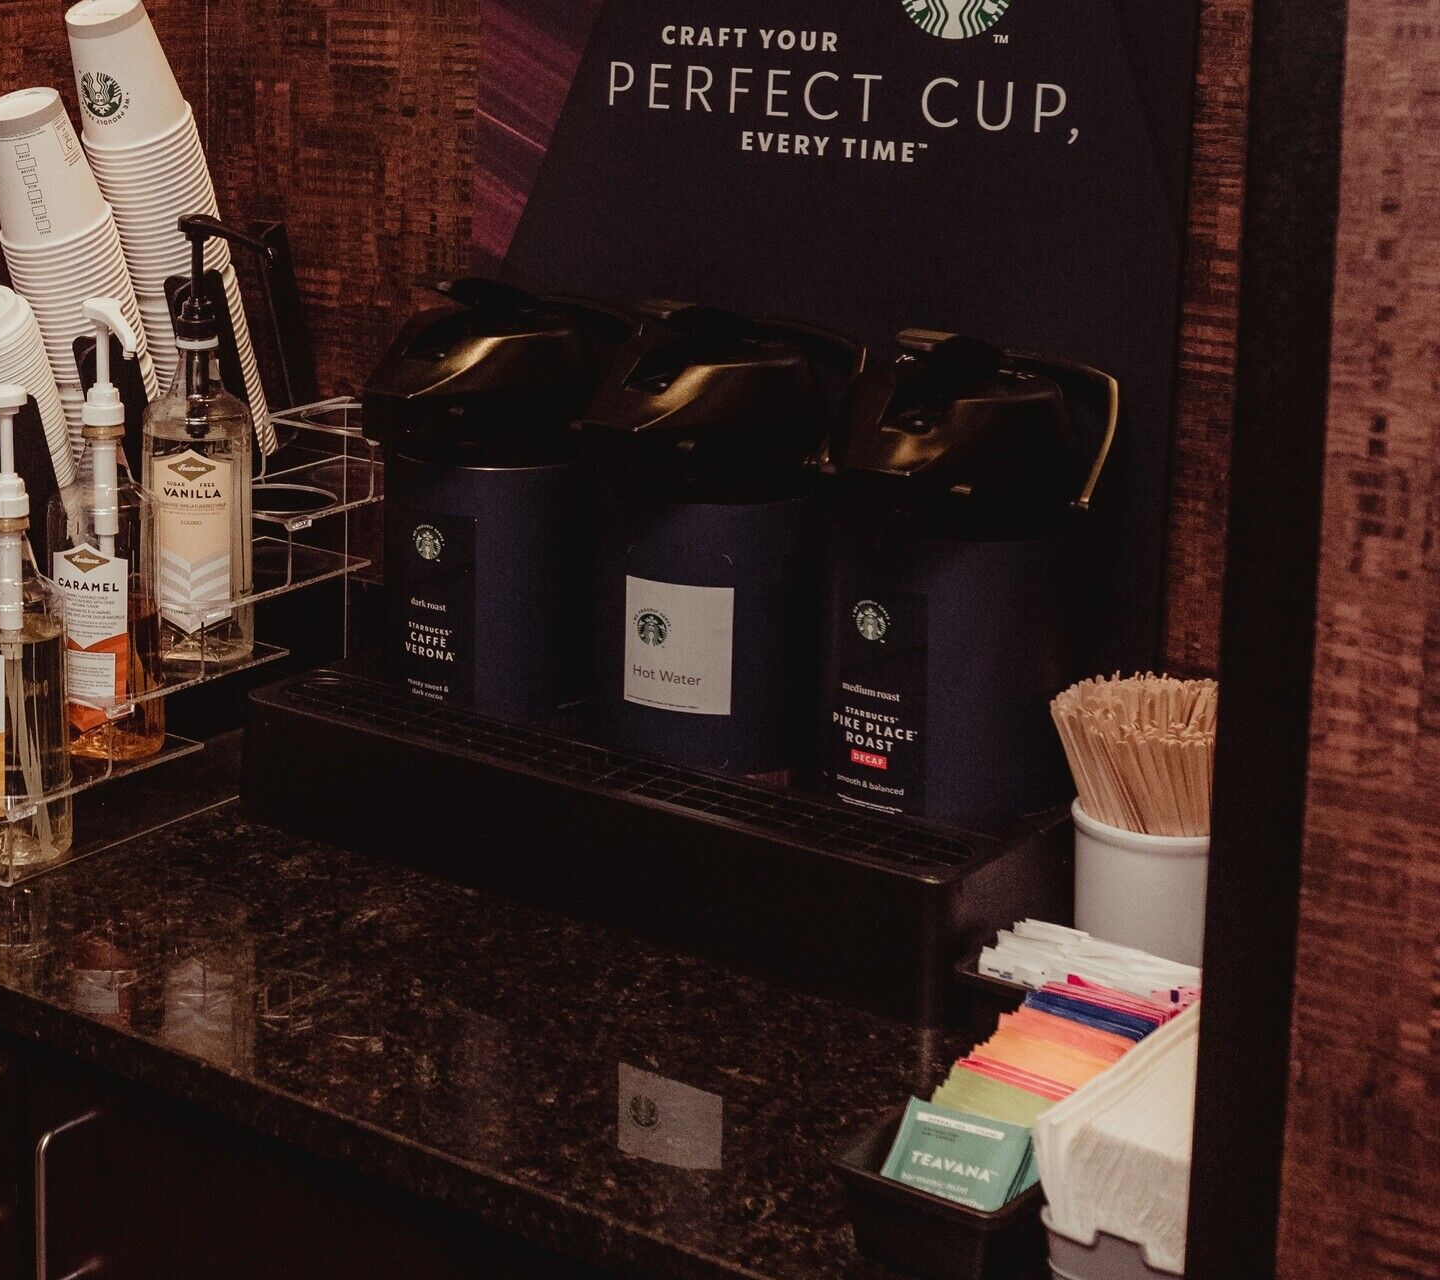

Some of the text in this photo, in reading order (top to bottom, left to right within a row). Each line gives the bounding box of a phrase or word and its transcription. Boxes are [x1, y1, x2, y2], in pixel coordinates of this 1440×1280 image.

[661, 25, 838, 52] CRAFT YOUR
[608, 61, 1079, 144] PERFECT CUP,
[741, 131, 830, 156] EVERY
[163, 487, 221, 499] VANILLA
[58, 577, 120, 593] CARAMEL
[410, 597, 447, 612] dark roast
[633, 664, 702, 686] Hot Water
[841, 681, 901, 703] medium roast
[832, 711, 860, 731] PIKE
[845, 730, 894, 753] ROAST
[853, 751, 885, 767] DECAF
[836, 773, 905, 796] smooth & balanced
[910, 1149, 991, 1184] TEAVANA
